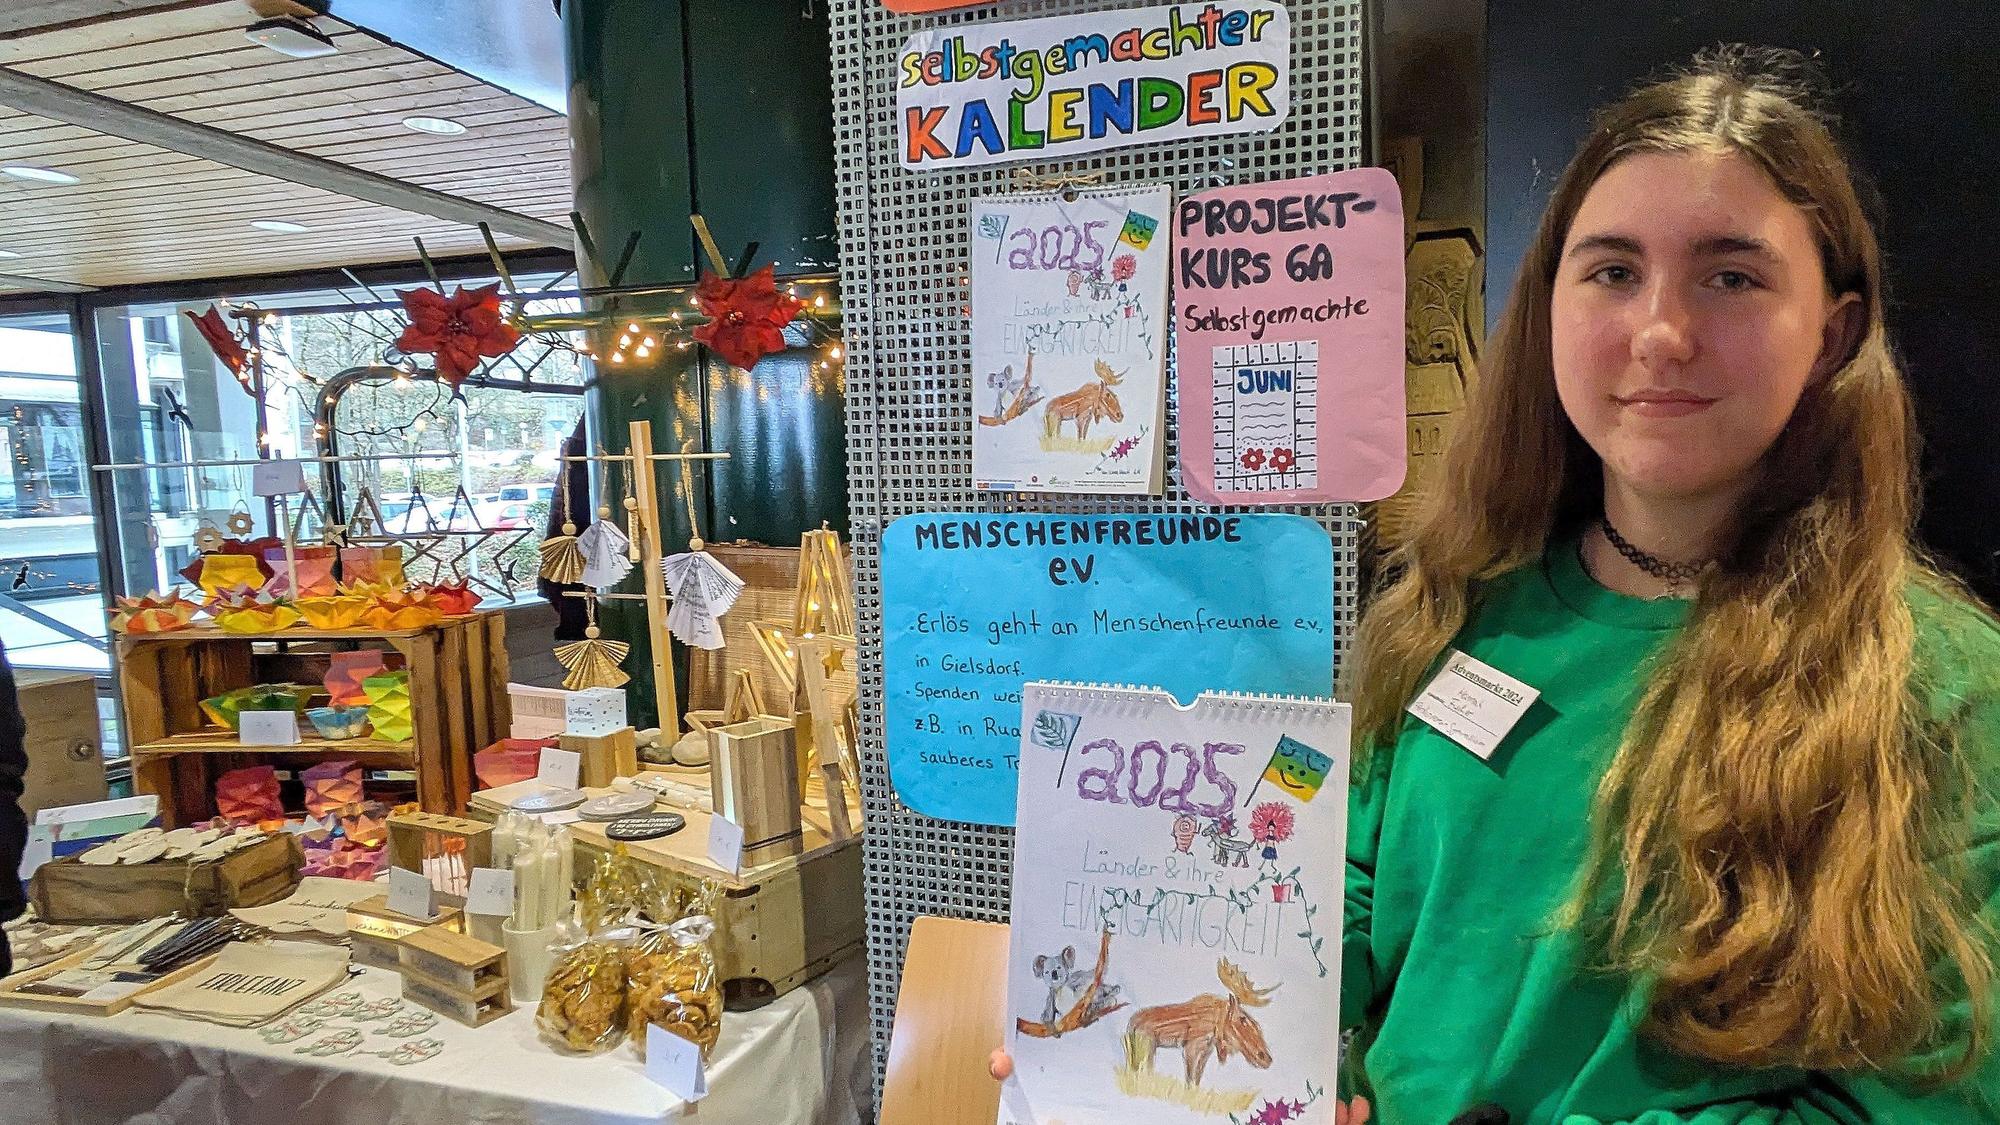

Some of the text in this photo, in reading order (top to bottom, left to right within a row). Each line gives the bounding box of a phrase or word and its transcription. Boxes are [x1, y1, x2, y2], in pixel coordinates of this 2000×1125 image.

[900, 5, 1275, 99] selbstgemachter
[905, 61, 1277, 164] KALENDER
[1180, 191, 1377, 237] PROJEKT-
[1008, 220, 1109, 272] 2025
[1180, 243, 1333, 289] KURS 6A
[1184, 296, 1369, 340] Selbstgemachte
[1236, 368, 1292, 395] JUNI
[915, 517, 1241, 550] MENSCHENFREUNDE
[1048, 554, 1100, 586] e.V.
[917, 611, 969, 634] Erlös
[988, 609, 1041, 645] geht
[1052, 619, 1078, 635] an
[1093, 608, 1281, 634] Menschenfreunde
[916, 654, 1025, 676] in Gielsdorf.
[1452, 662, 1504, 693] Adventsmarkt
[1501, 688, 1524, 704] 2024
[914, 681, 1024, 703] Spenden wei
[914, 714, 1021, 738] z.B. in Rua
[920, 751, 1020, 770] sauberes Tr
[1077, 738, 1246, 817] 2025
[1082, 840, 1224, 882] Länder & ihre
[195, 973, 307, 996] FIRLEFANZ
